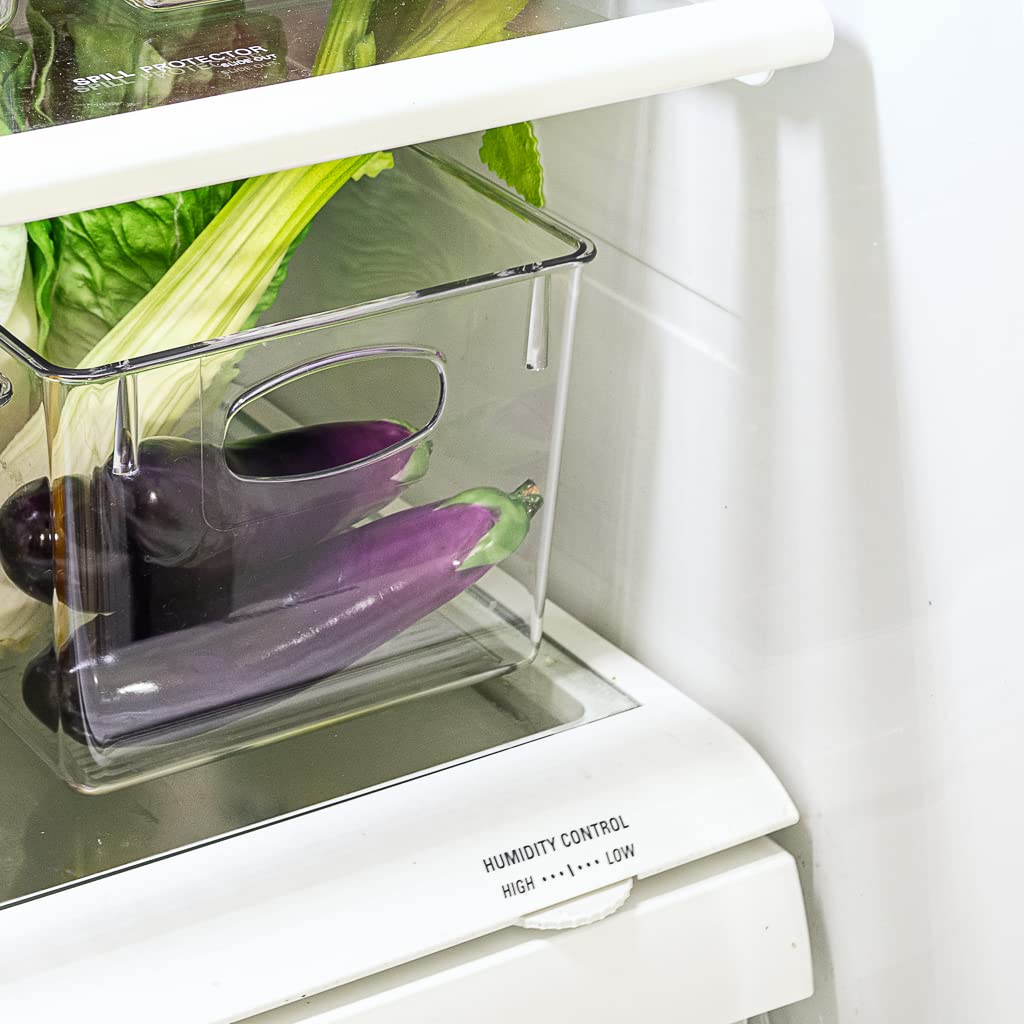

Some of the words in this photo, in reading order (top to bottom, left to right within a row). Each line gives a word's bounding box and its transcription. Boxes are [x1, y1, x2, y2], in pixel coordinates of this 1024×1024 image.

[73, 69, 136, 86] SPILL
[140, 45, 269, 74] PROTECTOR
[482, 836, 556, 873] HUMIDITY
[560, 815, 630, 848] CONTROL
[501, 875, 535, 899] HIGH
[606, 843, 636, 865] LOW
